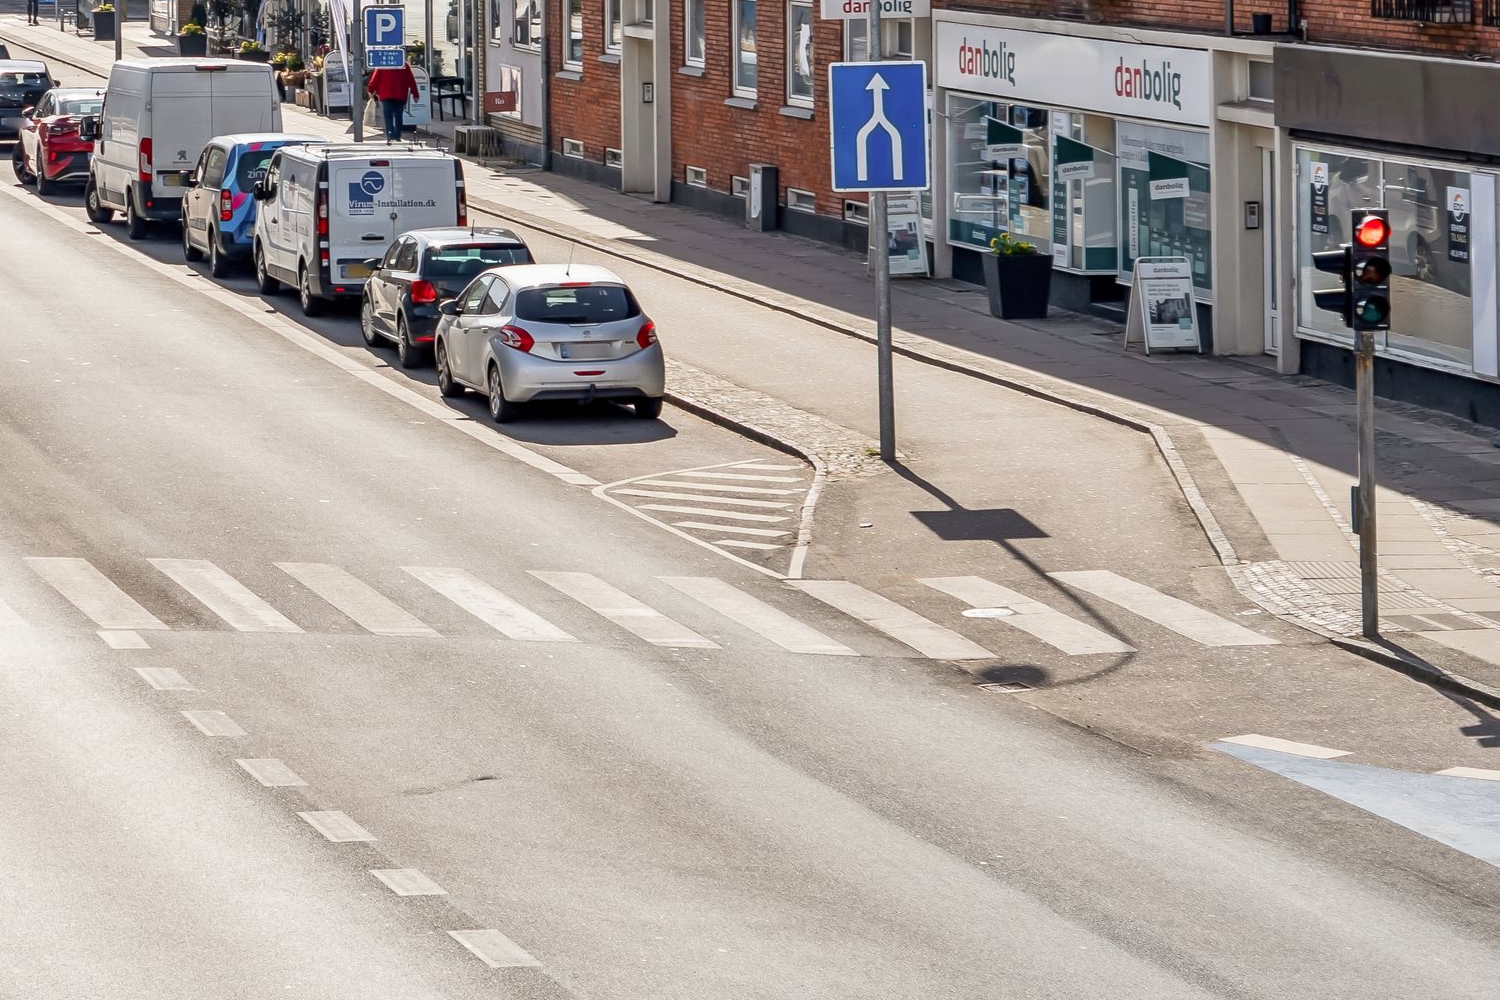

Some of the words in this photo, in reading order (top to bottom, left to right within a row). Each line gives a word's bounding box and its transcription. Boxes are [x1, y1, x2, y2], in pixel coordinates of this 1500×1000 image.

[376, 14, 396, 42] P
[958, 37, 1016, 86] danbolig
[1114, 56, 1182, 110] danbolig
[1062, 164, 1090, 174] danbolig
[1314, 175, 1325, 184] EDC
[1154, 182, 1184, 191] danbolig
[1453, 202, 1464, 212] EDC
